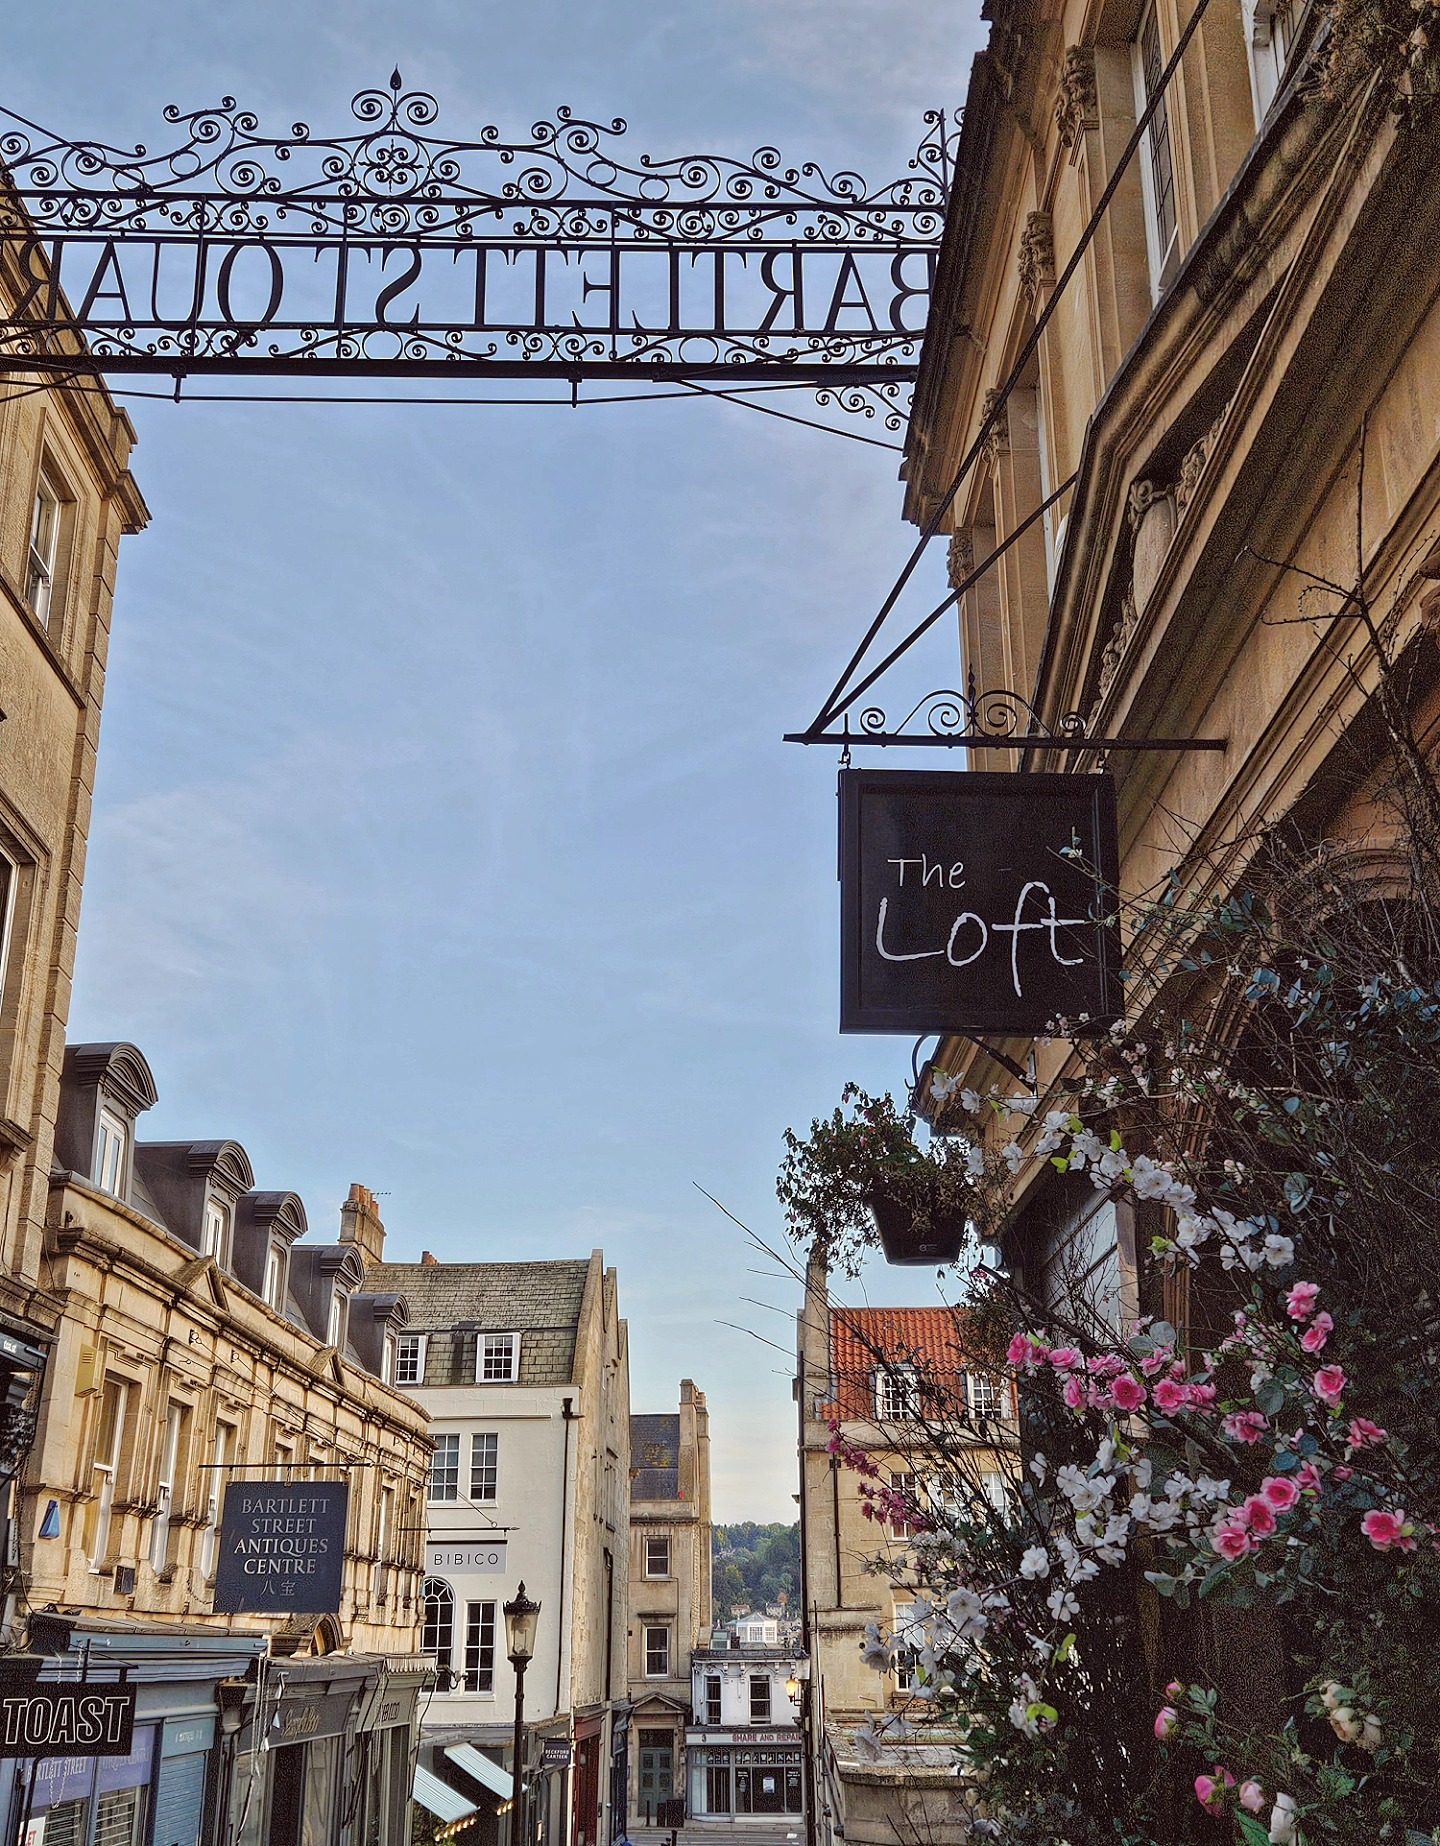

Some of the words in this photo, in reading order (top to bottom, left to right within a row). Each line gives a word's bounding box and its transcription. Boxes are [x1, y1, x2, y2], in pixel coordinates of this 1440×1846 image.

[887, 853, 965, 889] The
[876, 881, 1085, 997] Loft
[241, 1498, 331, 1514] BARTLETT
[251, 1518, 317, 1534] STREET
[233, 1538, 329, 1557] ANTIQUES
[243, 1558, 316, 1575] CENTRE
[434, 1553, 499, 1565] BIBICO
[3, 1696, 130, 1745] TOAST
[732, 1733, 757, 1742] SHARE
[760, 1734, 774, 1742] AND
[26, 1760, 62, 1784] BRTLETT
